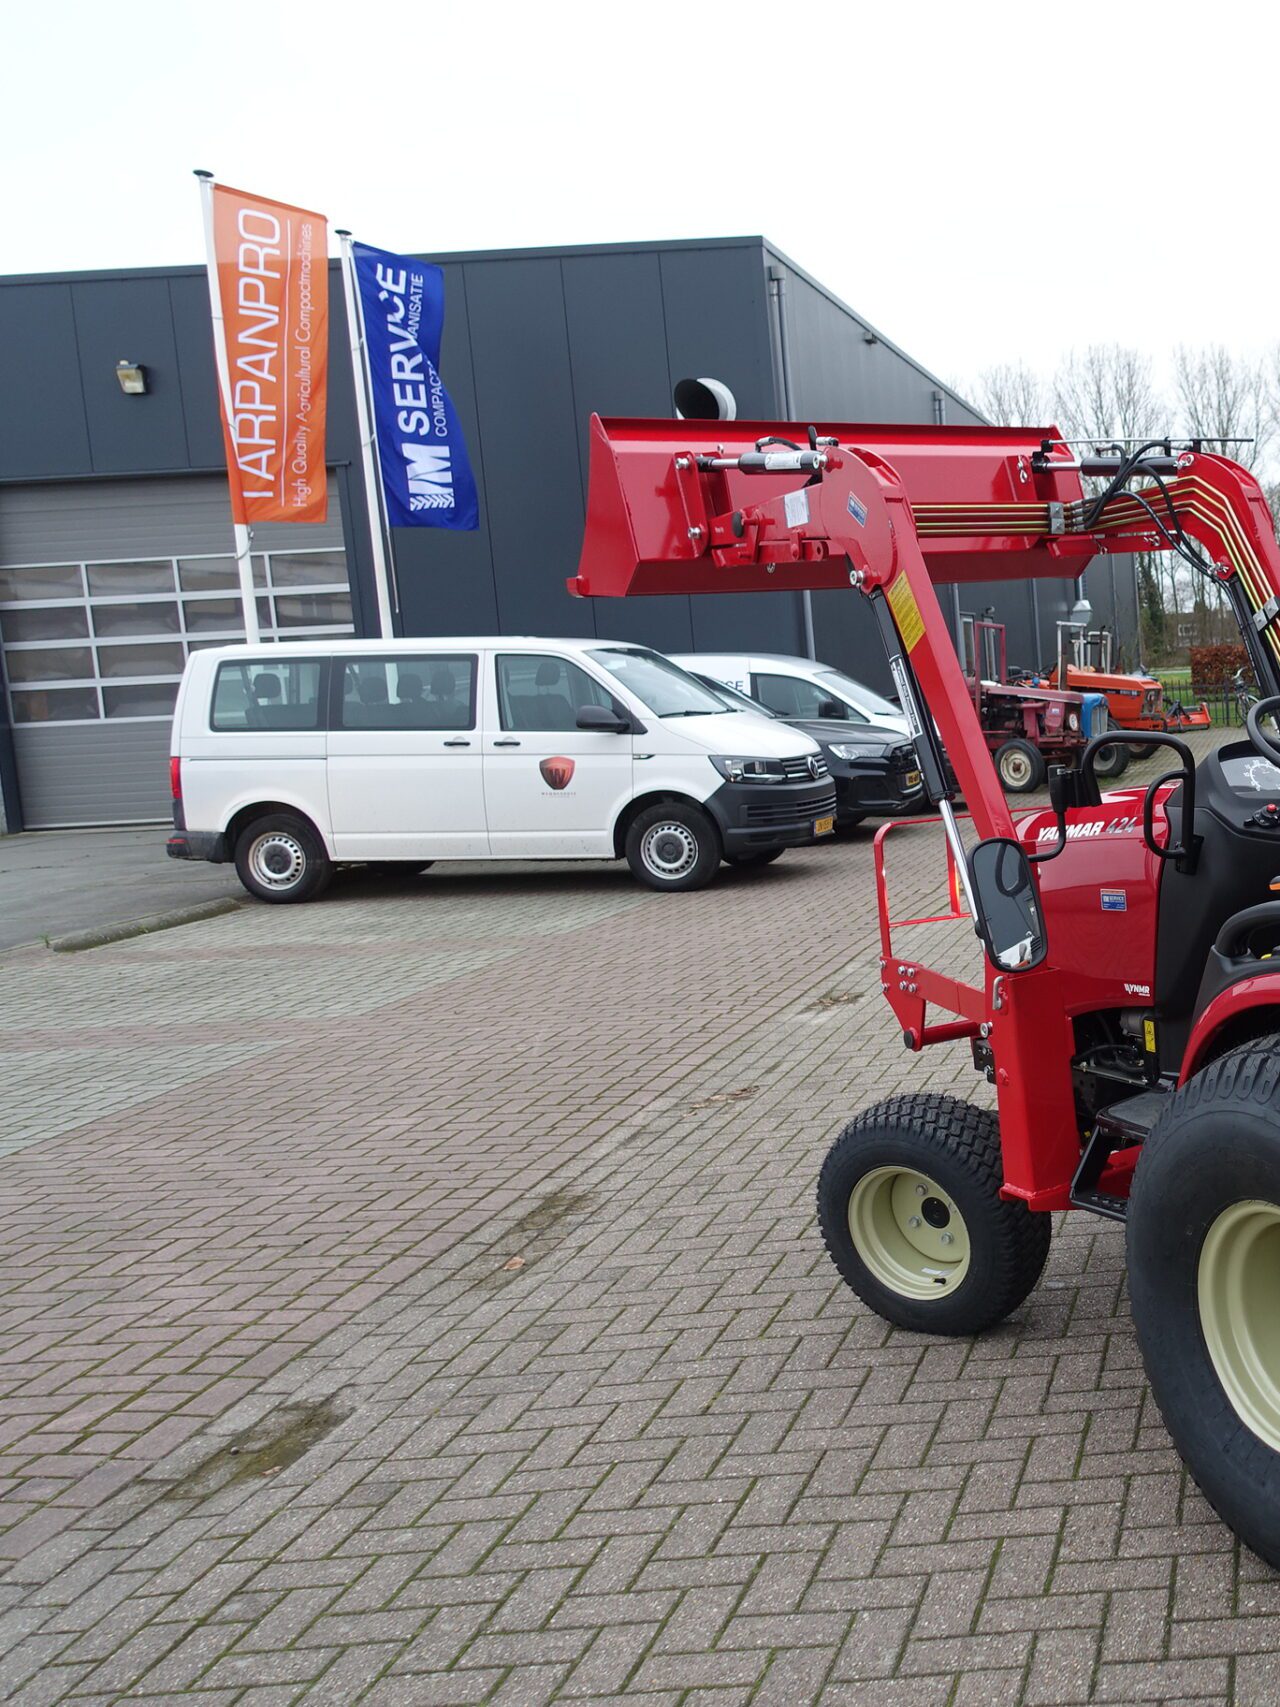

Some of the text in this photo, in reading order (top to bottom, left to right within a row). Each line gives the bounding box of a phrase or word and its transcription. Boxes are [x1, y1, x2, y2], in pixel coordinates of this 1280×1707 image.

[294, 346, 311, 422] Agricultural
[291, 425, 311, 474] Quality
[291, 478, 312, 507] High
[1104, 816, 1138, 834] 424
